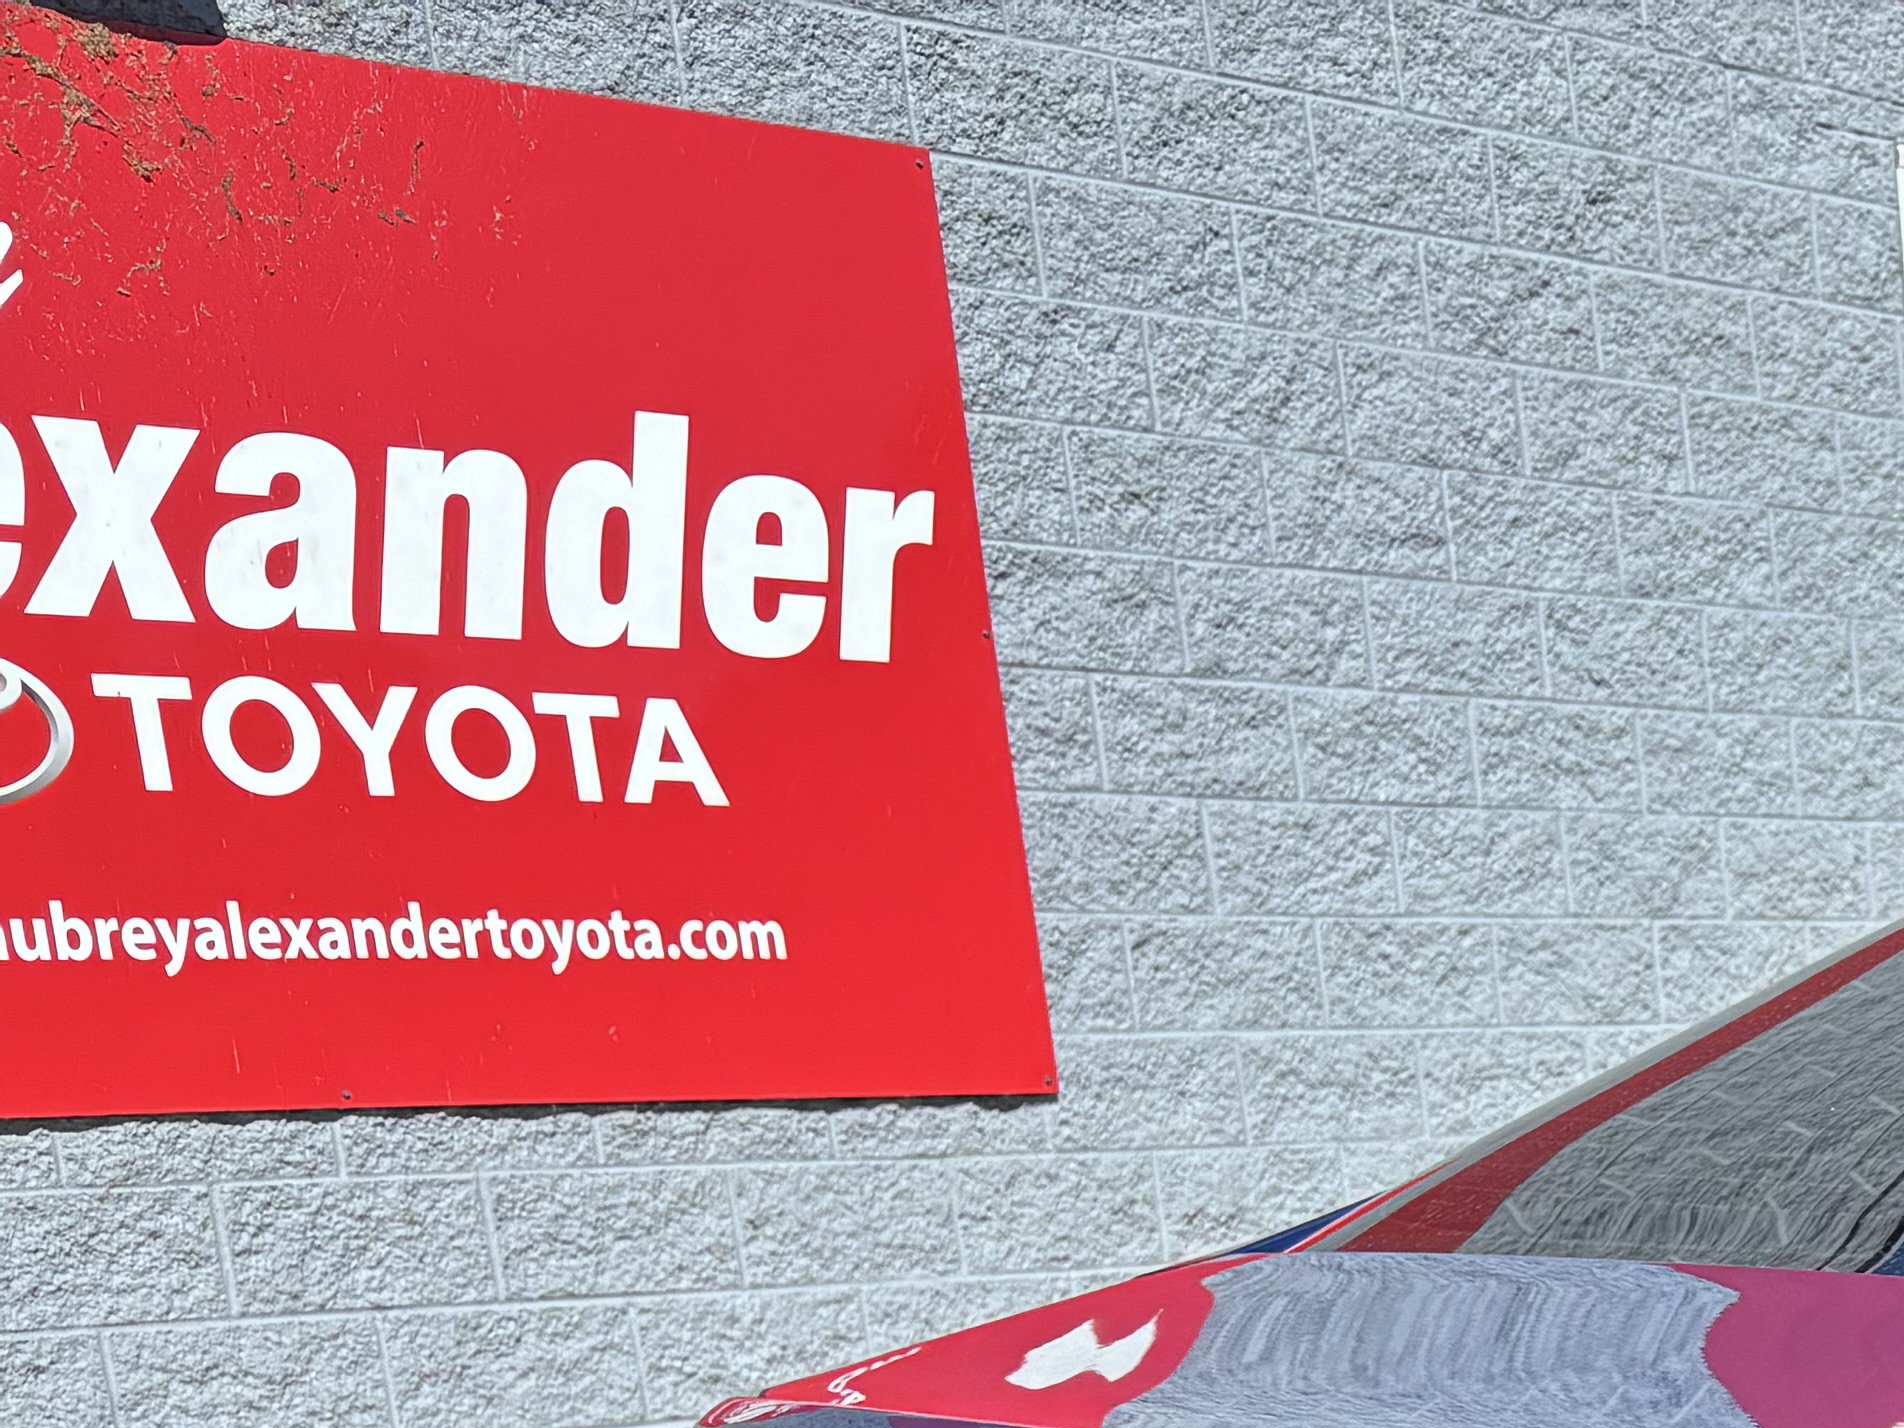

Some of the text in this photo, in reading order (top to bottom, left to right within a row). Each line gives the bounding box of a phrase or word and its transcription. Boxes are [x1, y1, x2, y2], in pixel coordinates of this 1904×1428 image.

[0, 410, 935, 663] xander
[91, 673, 730, 807] TOYOTA
[0, 899, 787, 977] ubreyalexandertoyota.com
